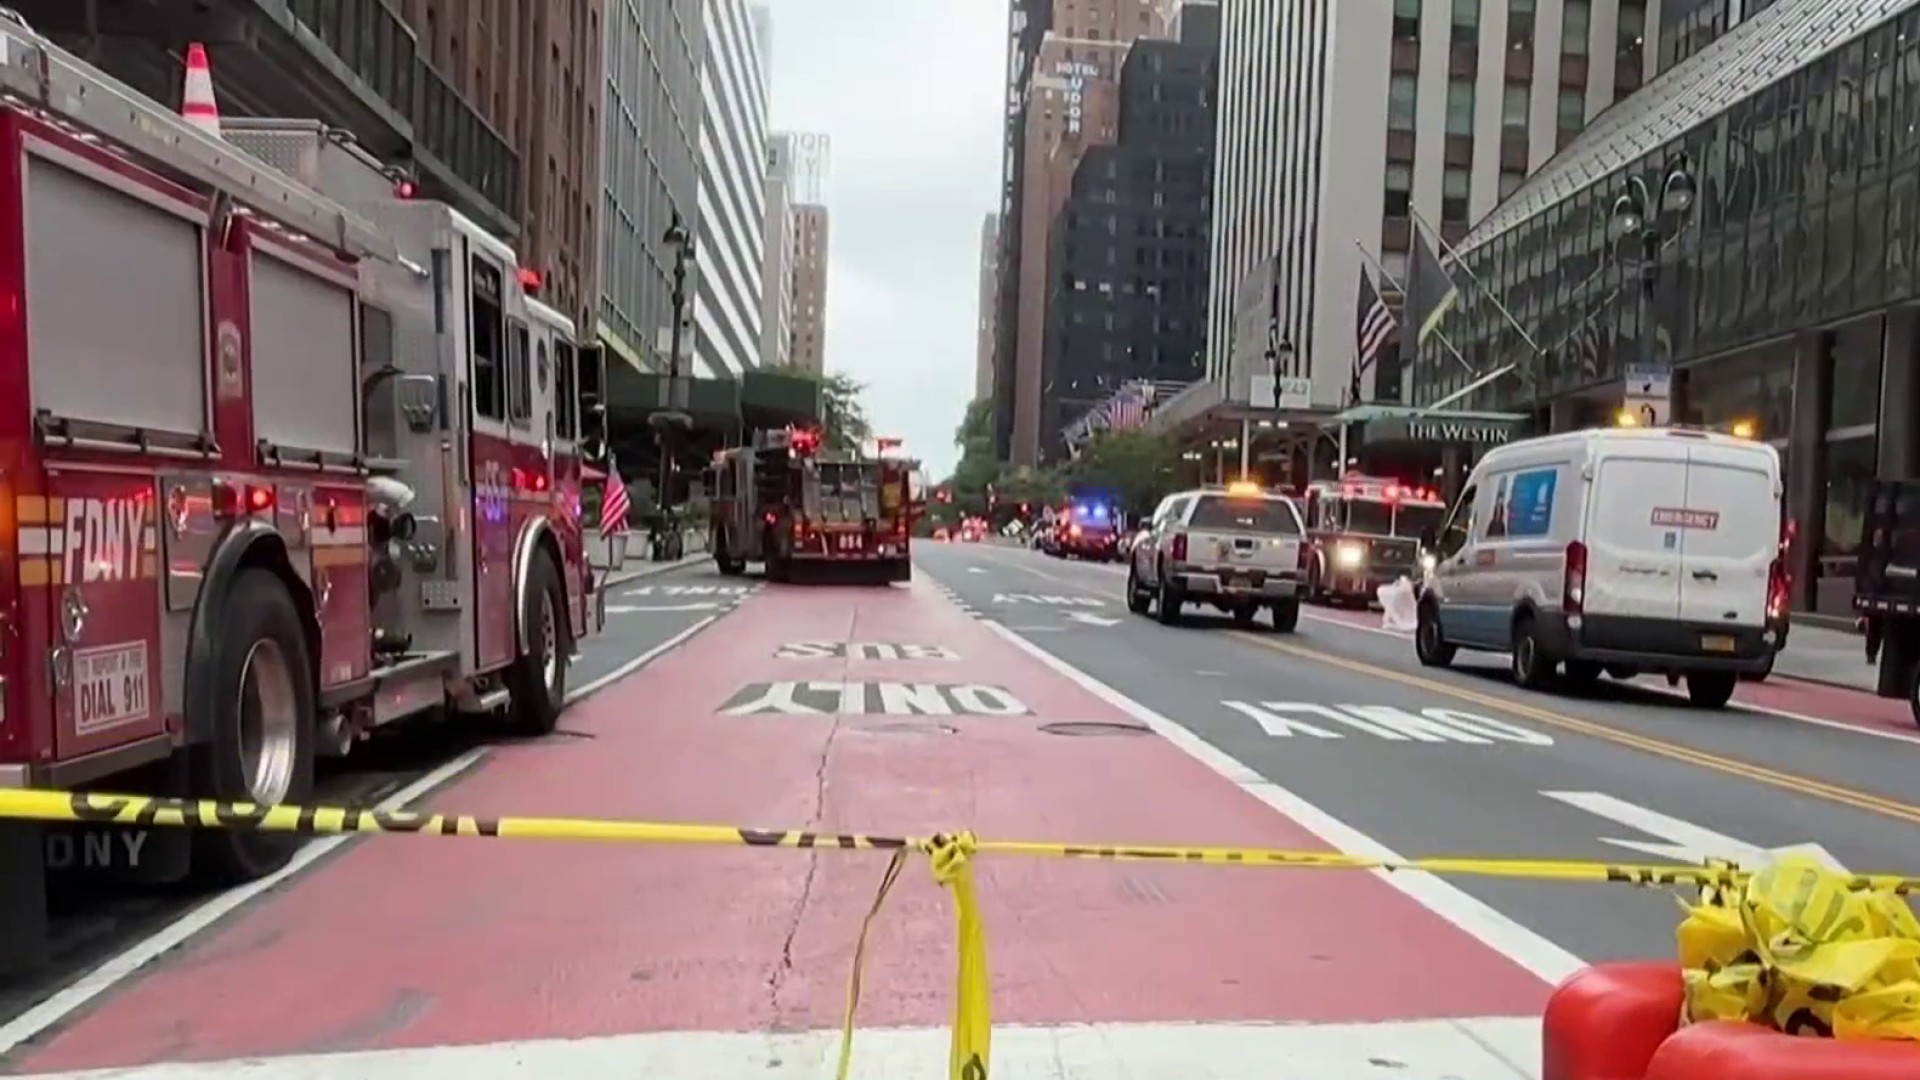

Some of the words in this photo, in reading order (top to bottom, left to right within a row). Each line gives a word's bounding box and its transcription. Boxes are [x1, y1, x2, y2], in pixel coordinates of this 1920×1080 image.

[1056, 62, 1099, 76] HOTEL
[1408, 421, 1436, 439] THE
[1442, 423, 1508, 442] WESTIN
[1655, 510, 1718, 529] EMERGENCY
[64, 497, 145, 584] FDNY
[771, 641, 961, 661] BUS
[80, 678, 116, 723] DIAL
[123, 673, 145, 713] 911
[714, 681, 1032, 715] ONLY
[1220, 700, 1555, 746] ONLY
